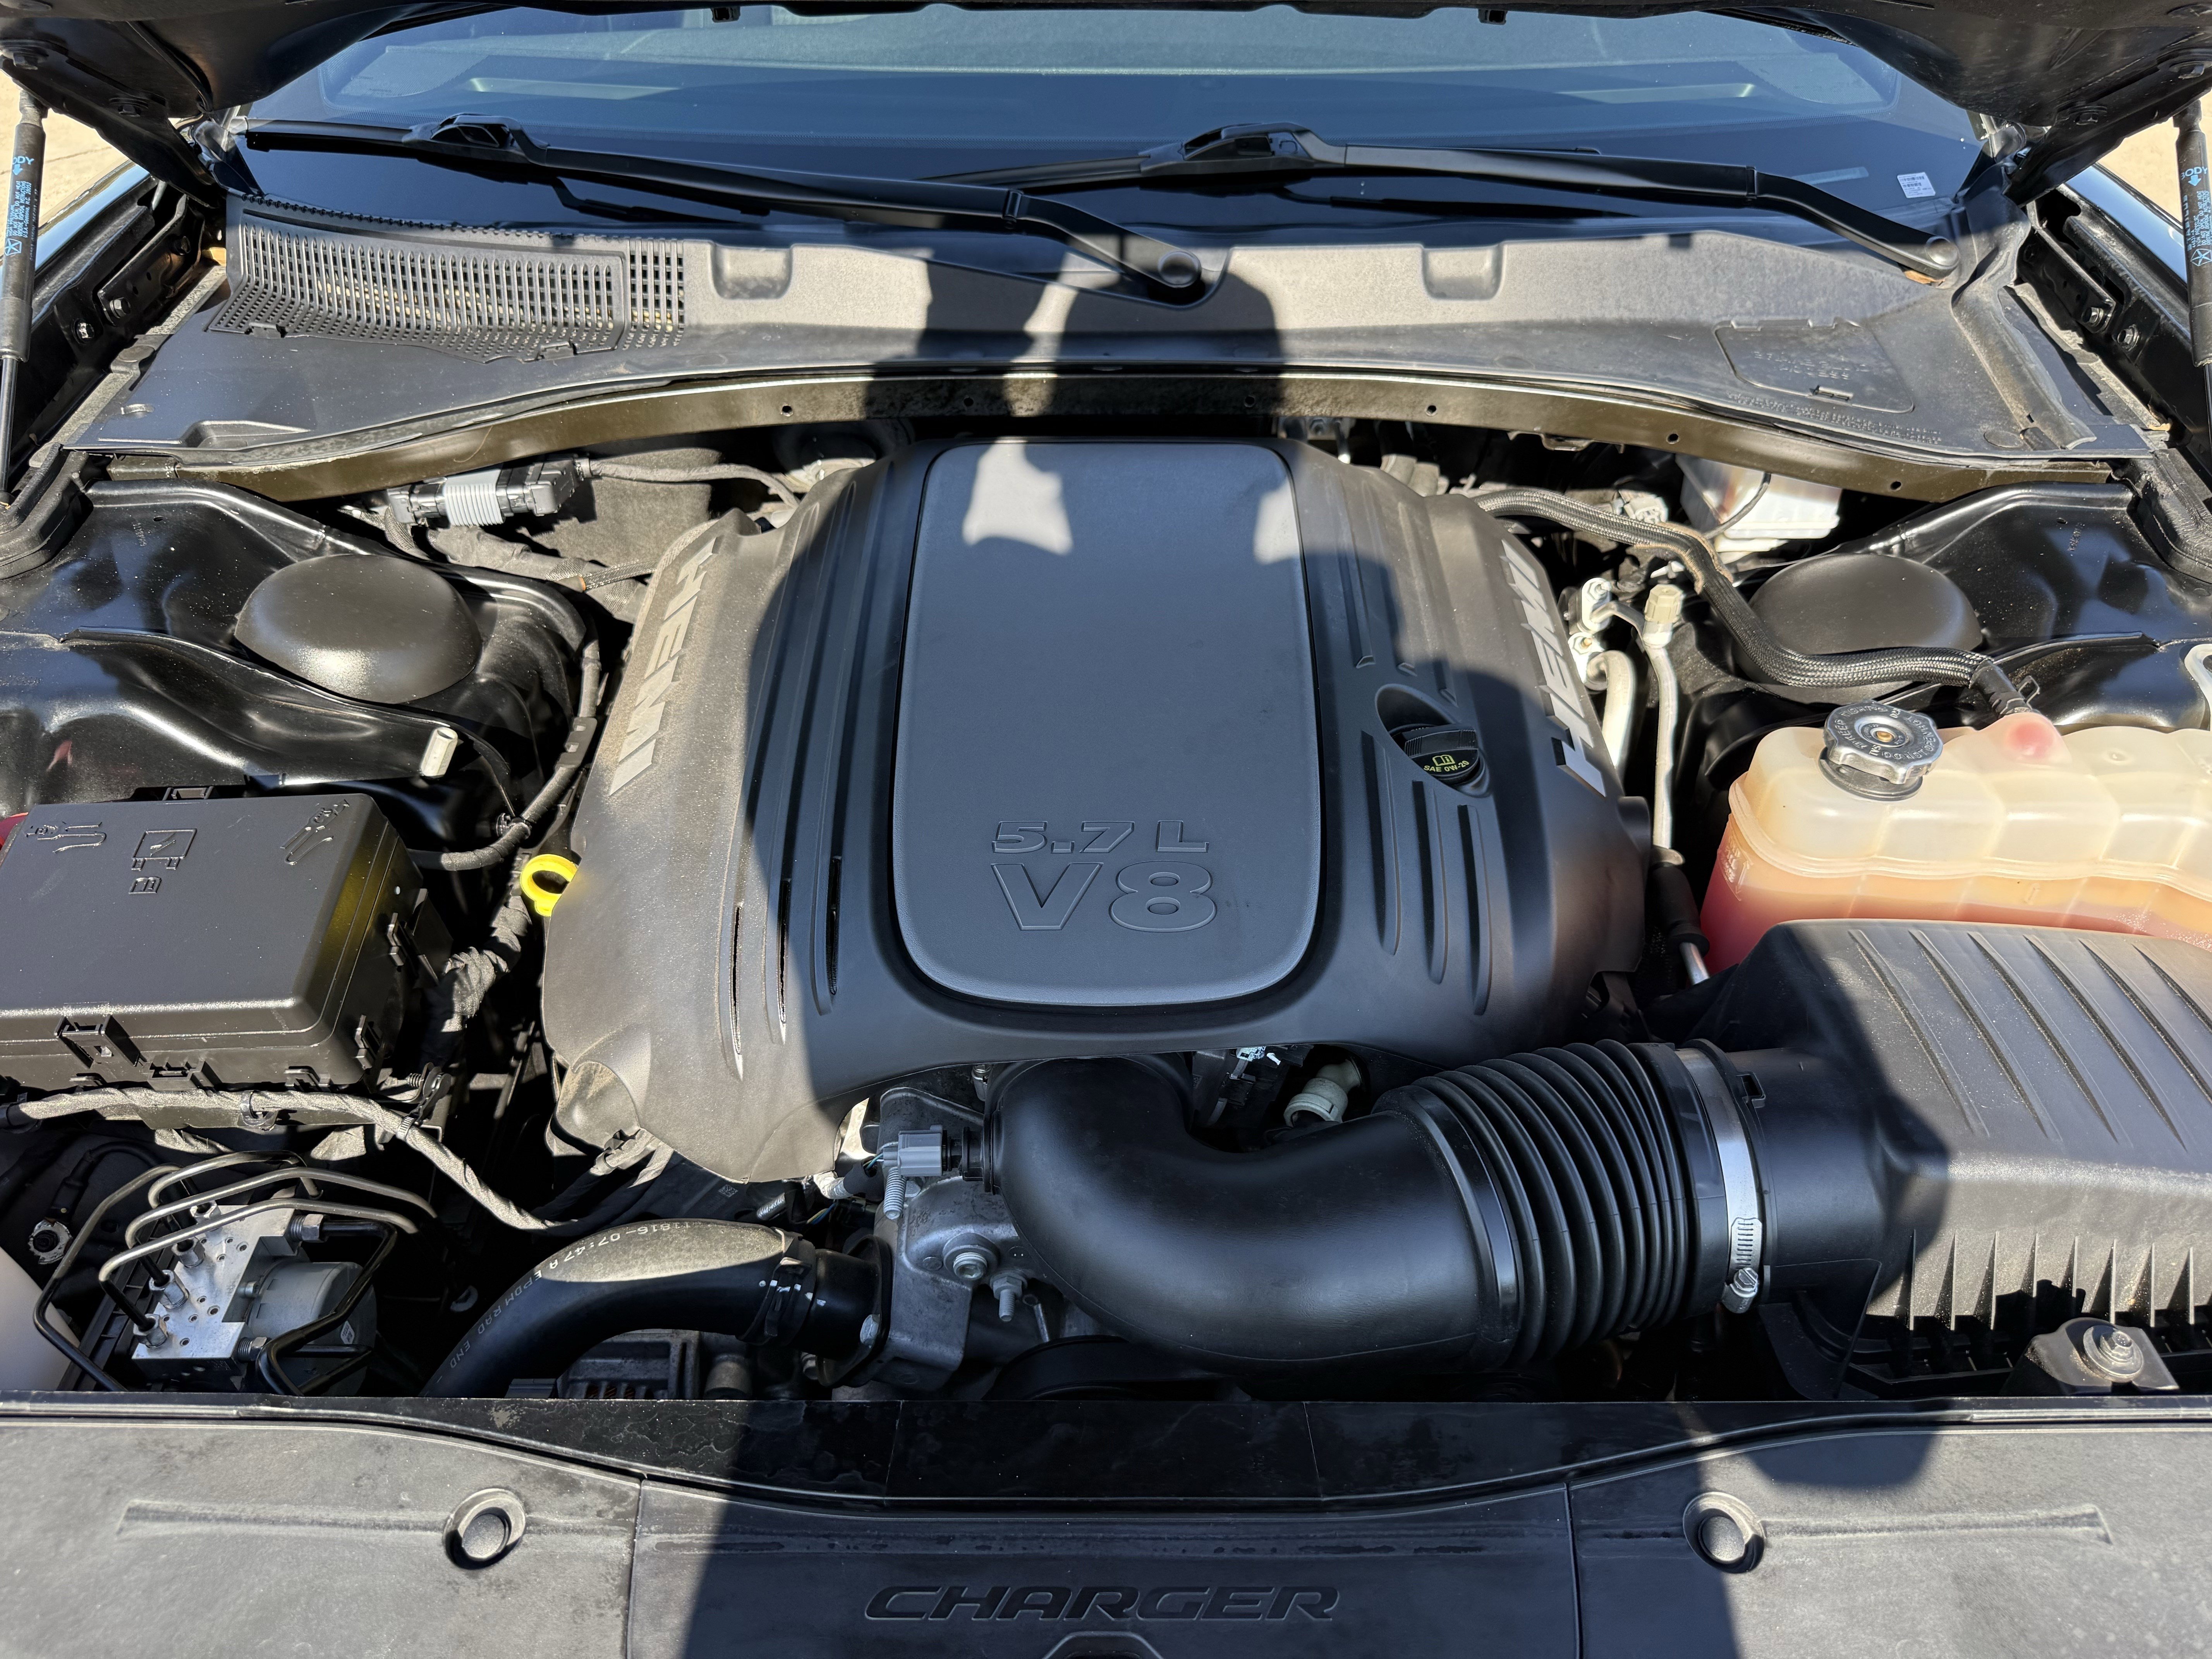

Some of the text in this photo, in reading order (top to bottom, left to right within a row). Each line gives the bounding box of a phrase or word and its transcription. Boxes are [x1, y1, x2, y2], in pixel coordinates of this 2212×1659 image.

[12, 156, 34, 165] ODY
[609, 537, 716, 796] HEMI
[1501, 539, 1606, 798] HEMI
[1444, 760, 1469, 772] 0W-20
[992, 821, 1209, 854] 5.7 L
[990, 860, 1218, 933] V8
[550, 1259, 558, 1269] A
[505, 1270, 542, 1306] EPDM
[478, 1305, 502, 1334] RAD
[450, 1340, 471, 1369] END
[864, 1585, 1340, 1621] CHARGER
